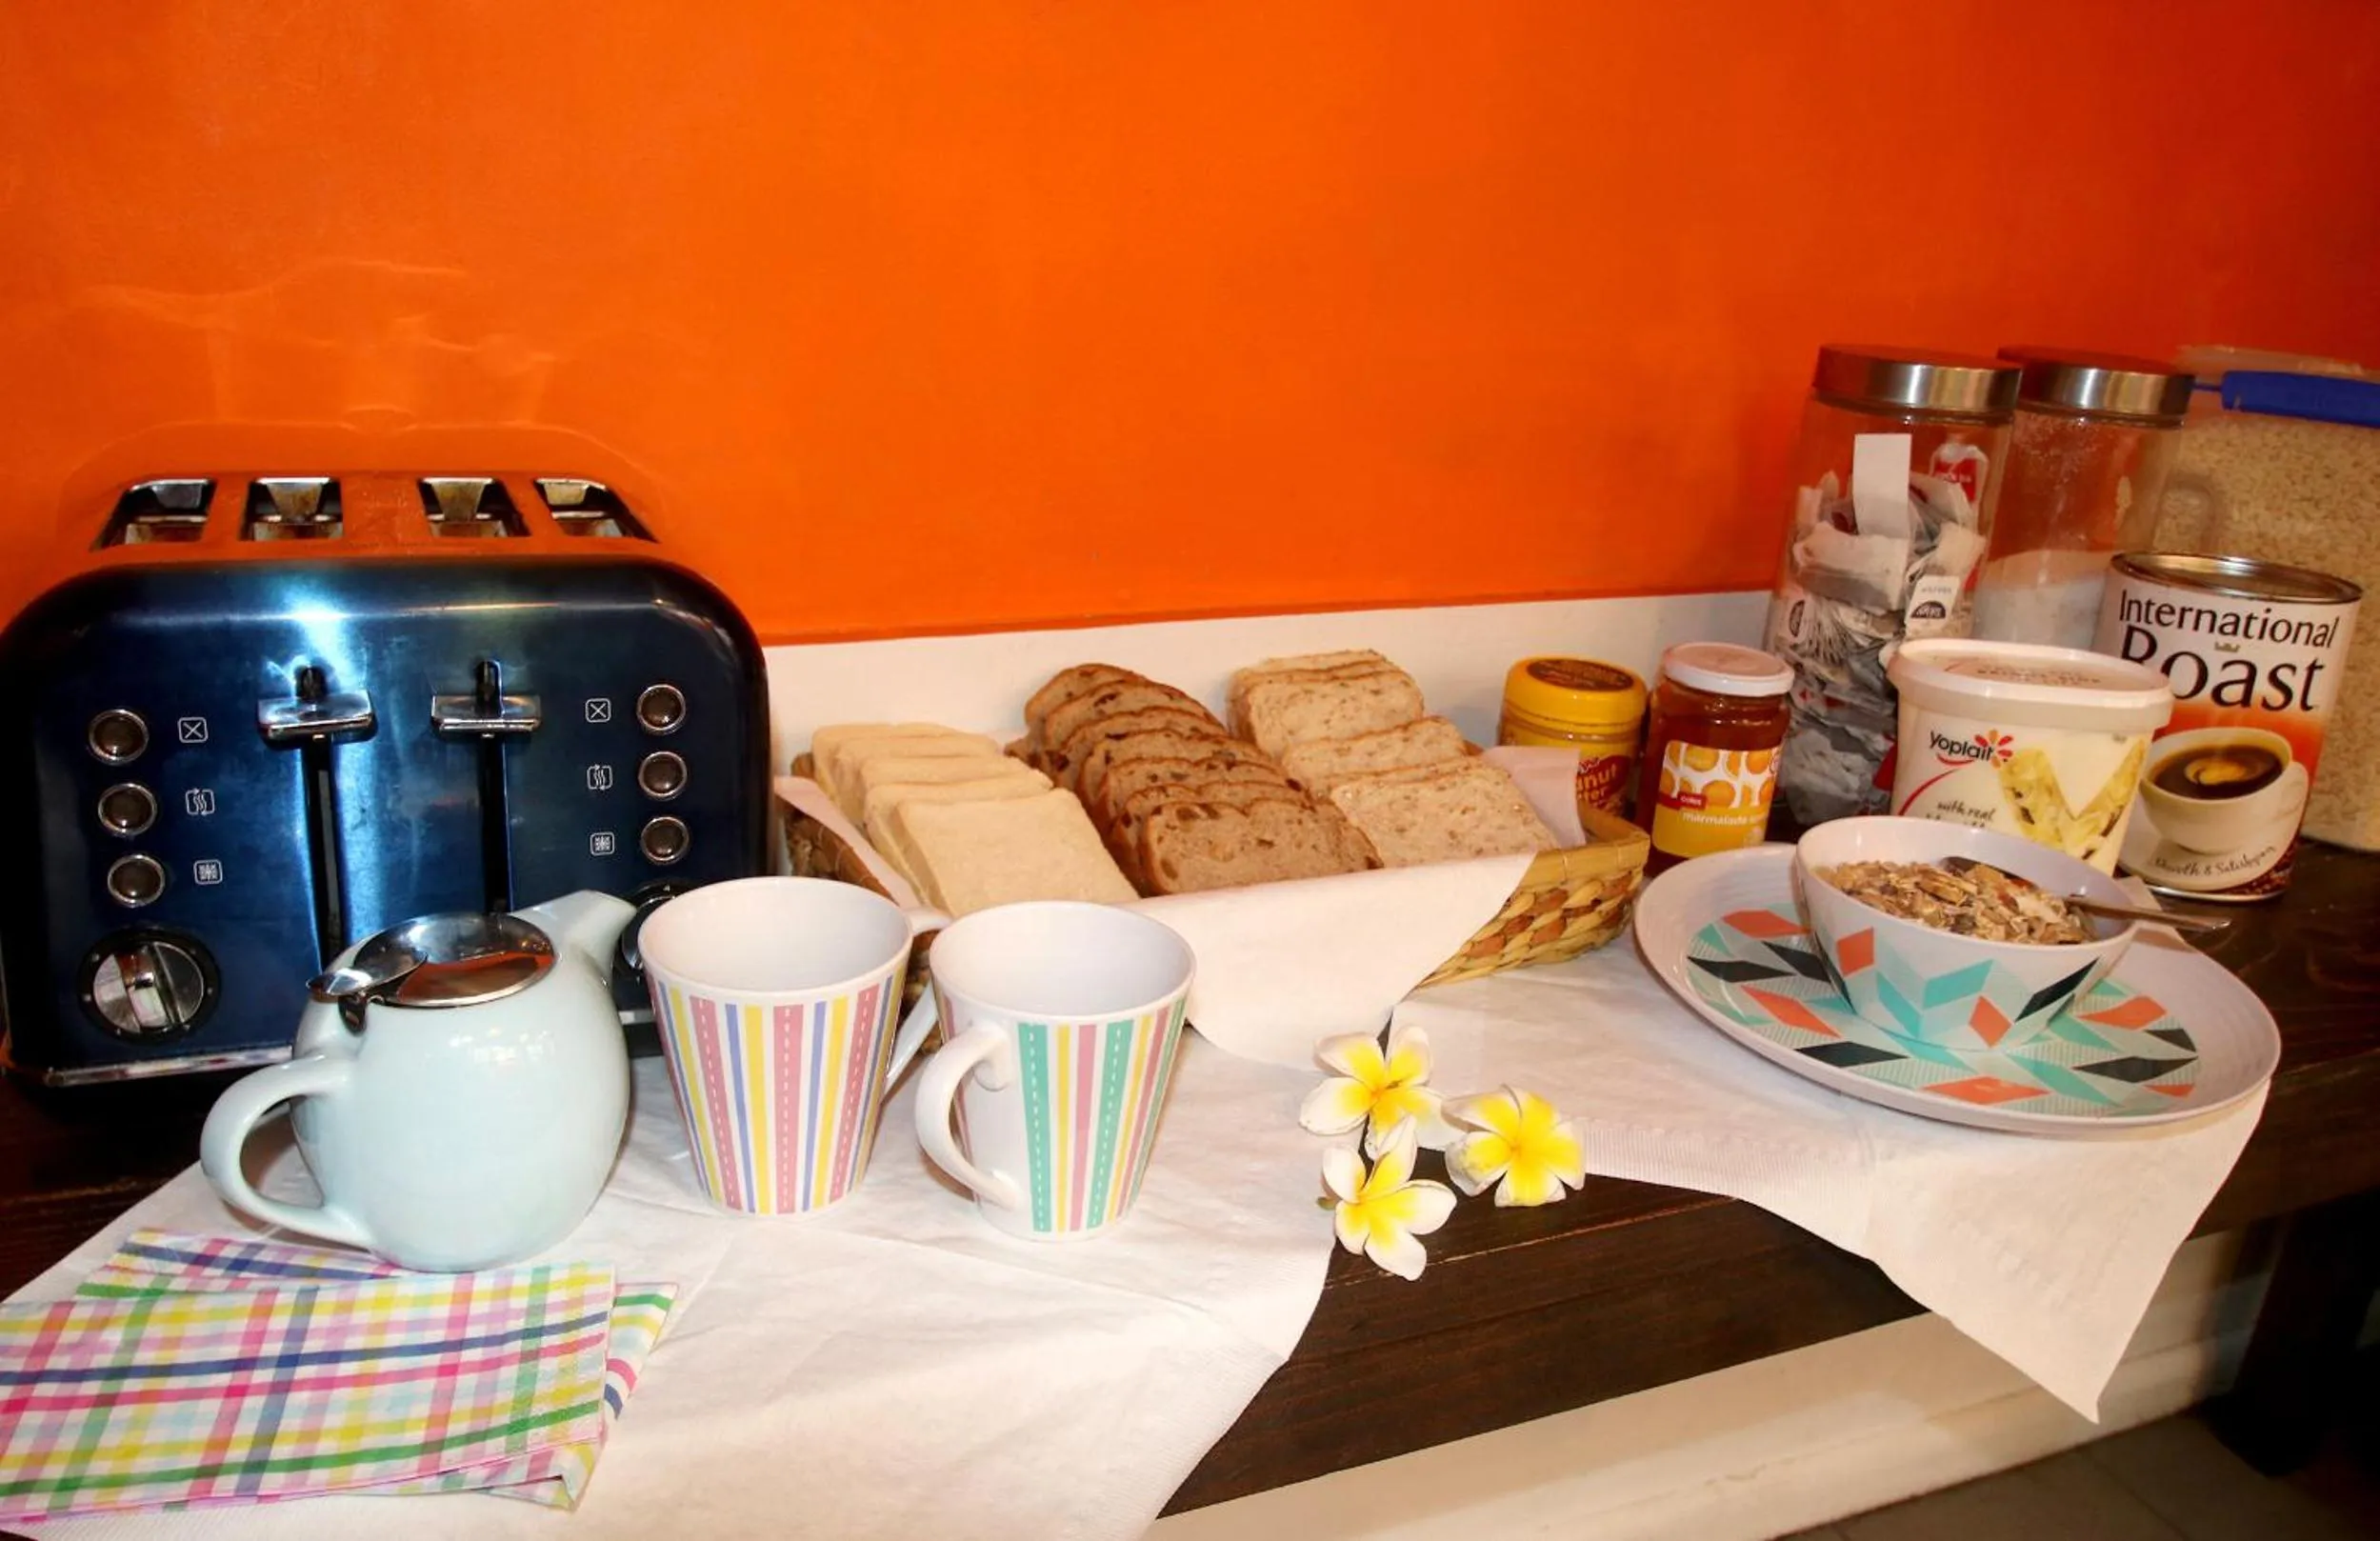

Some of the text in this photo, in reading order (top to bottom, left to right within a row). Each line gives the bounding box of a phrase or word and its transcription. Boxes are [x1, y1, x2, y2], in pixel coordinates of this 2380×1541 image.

[2120, 590, 2339, 649] International
[1930, 730, 1994, 762] Yoplait
[1682, 811, 1749, 826] marmalade
[1968, 807, 1996, 822] real
